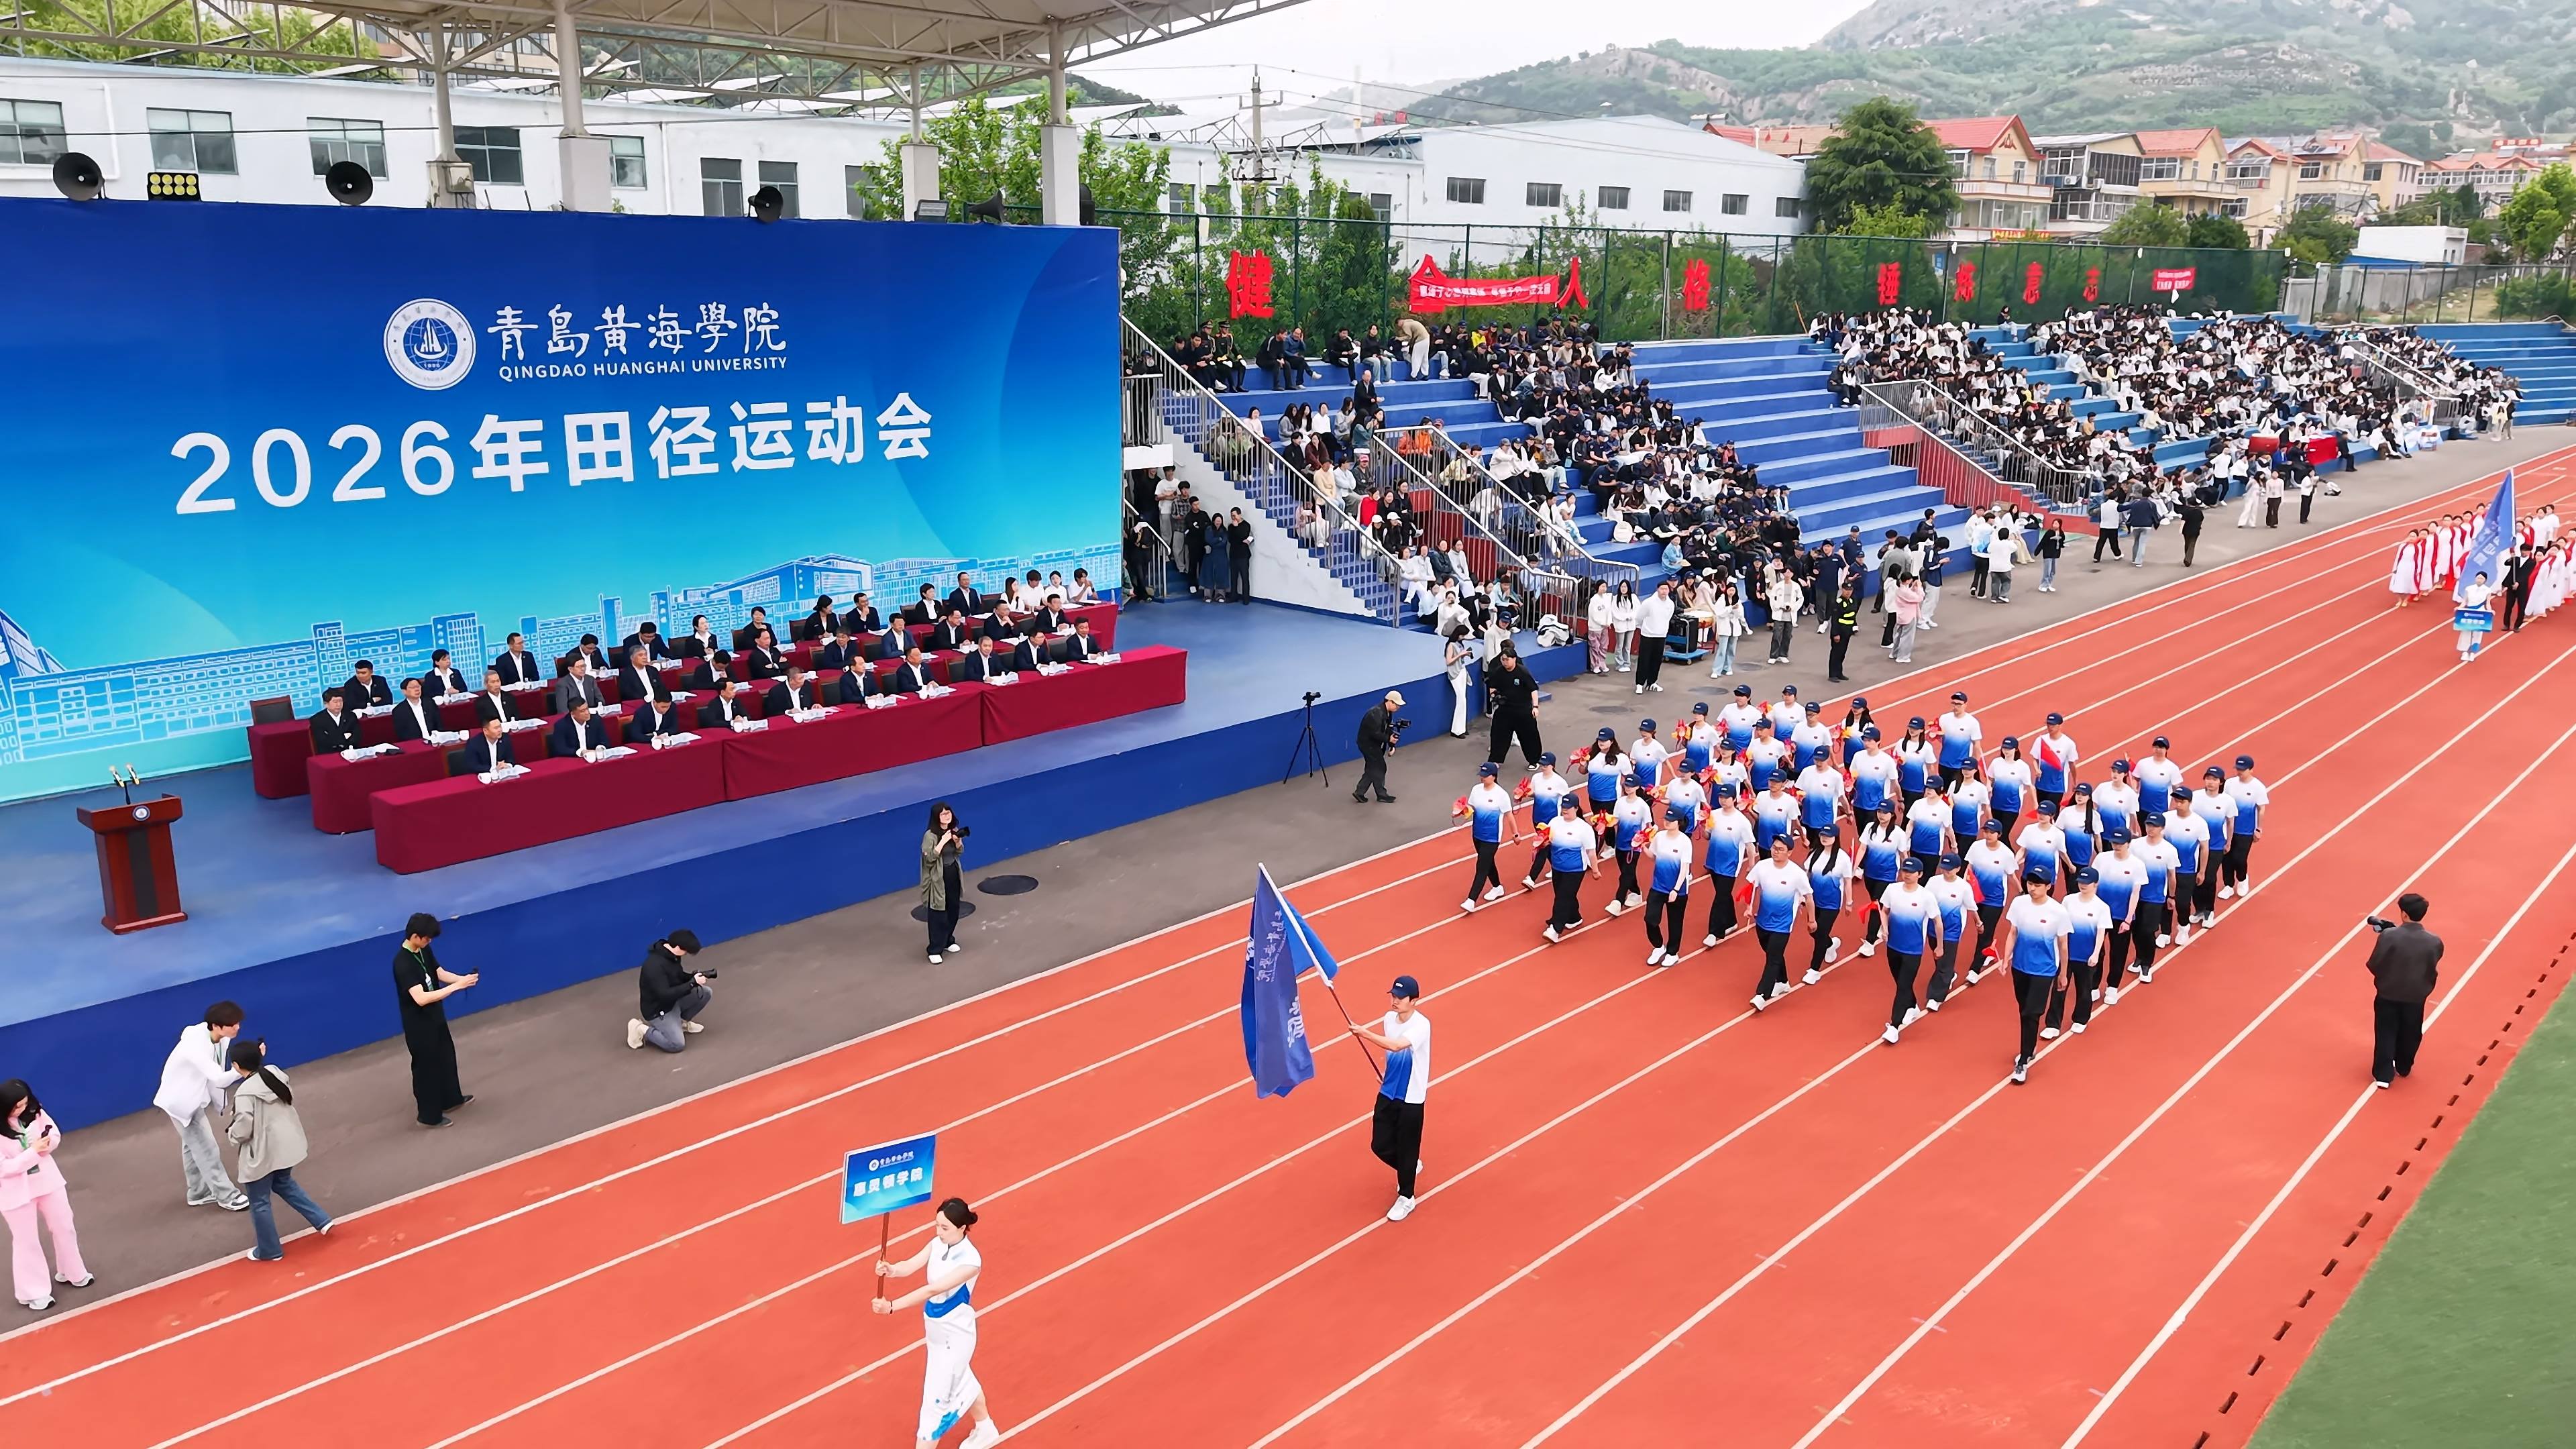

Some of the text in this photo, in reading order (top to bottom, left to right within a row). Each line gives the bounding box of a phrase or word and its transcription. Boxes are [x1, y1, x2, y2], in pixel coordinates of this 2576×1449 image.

[1225, 249, 1274, 319] 健
[499, 357, 787, 382] QINGDAO HUANGHAI UNIVERSITY
[171, 391, 932, 515] 2026年田径运动会
